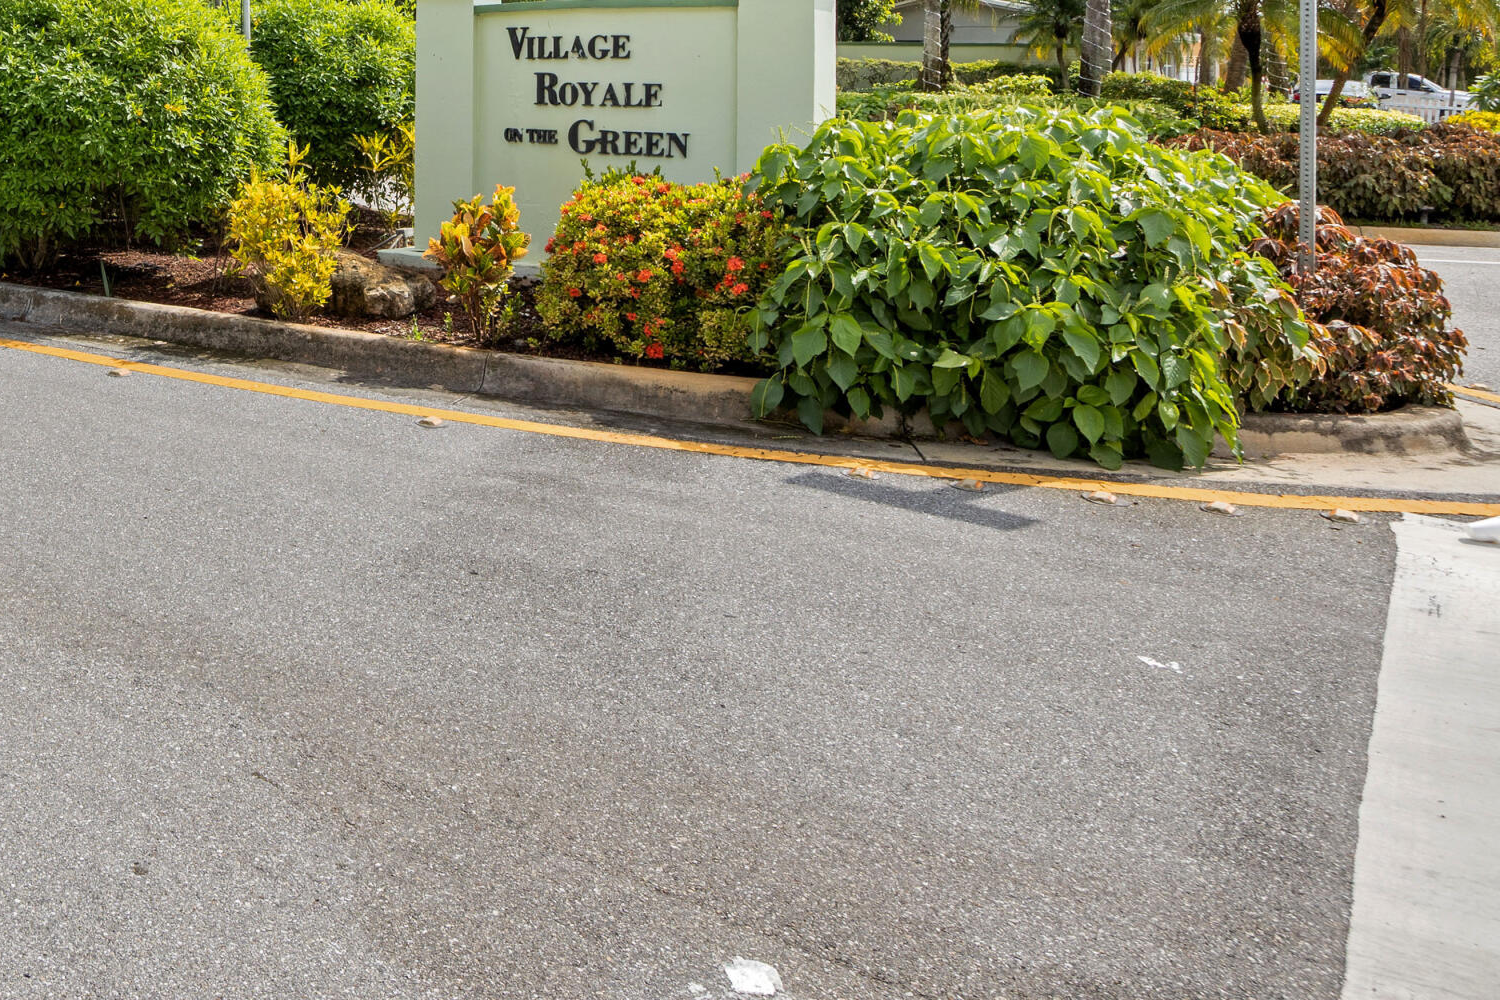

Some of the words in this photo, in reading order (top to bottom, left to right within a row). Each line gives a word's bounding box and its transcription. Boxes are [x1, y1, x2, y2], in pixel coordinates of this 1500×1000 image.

[506, 26, 631, 60] VILLAGE
[534, 72, 662, 108] ROYALE
[503, 127, 524, 143] ON
[526, 128, 558, 145] THE
[567, 119, 690, 159] GREEN
